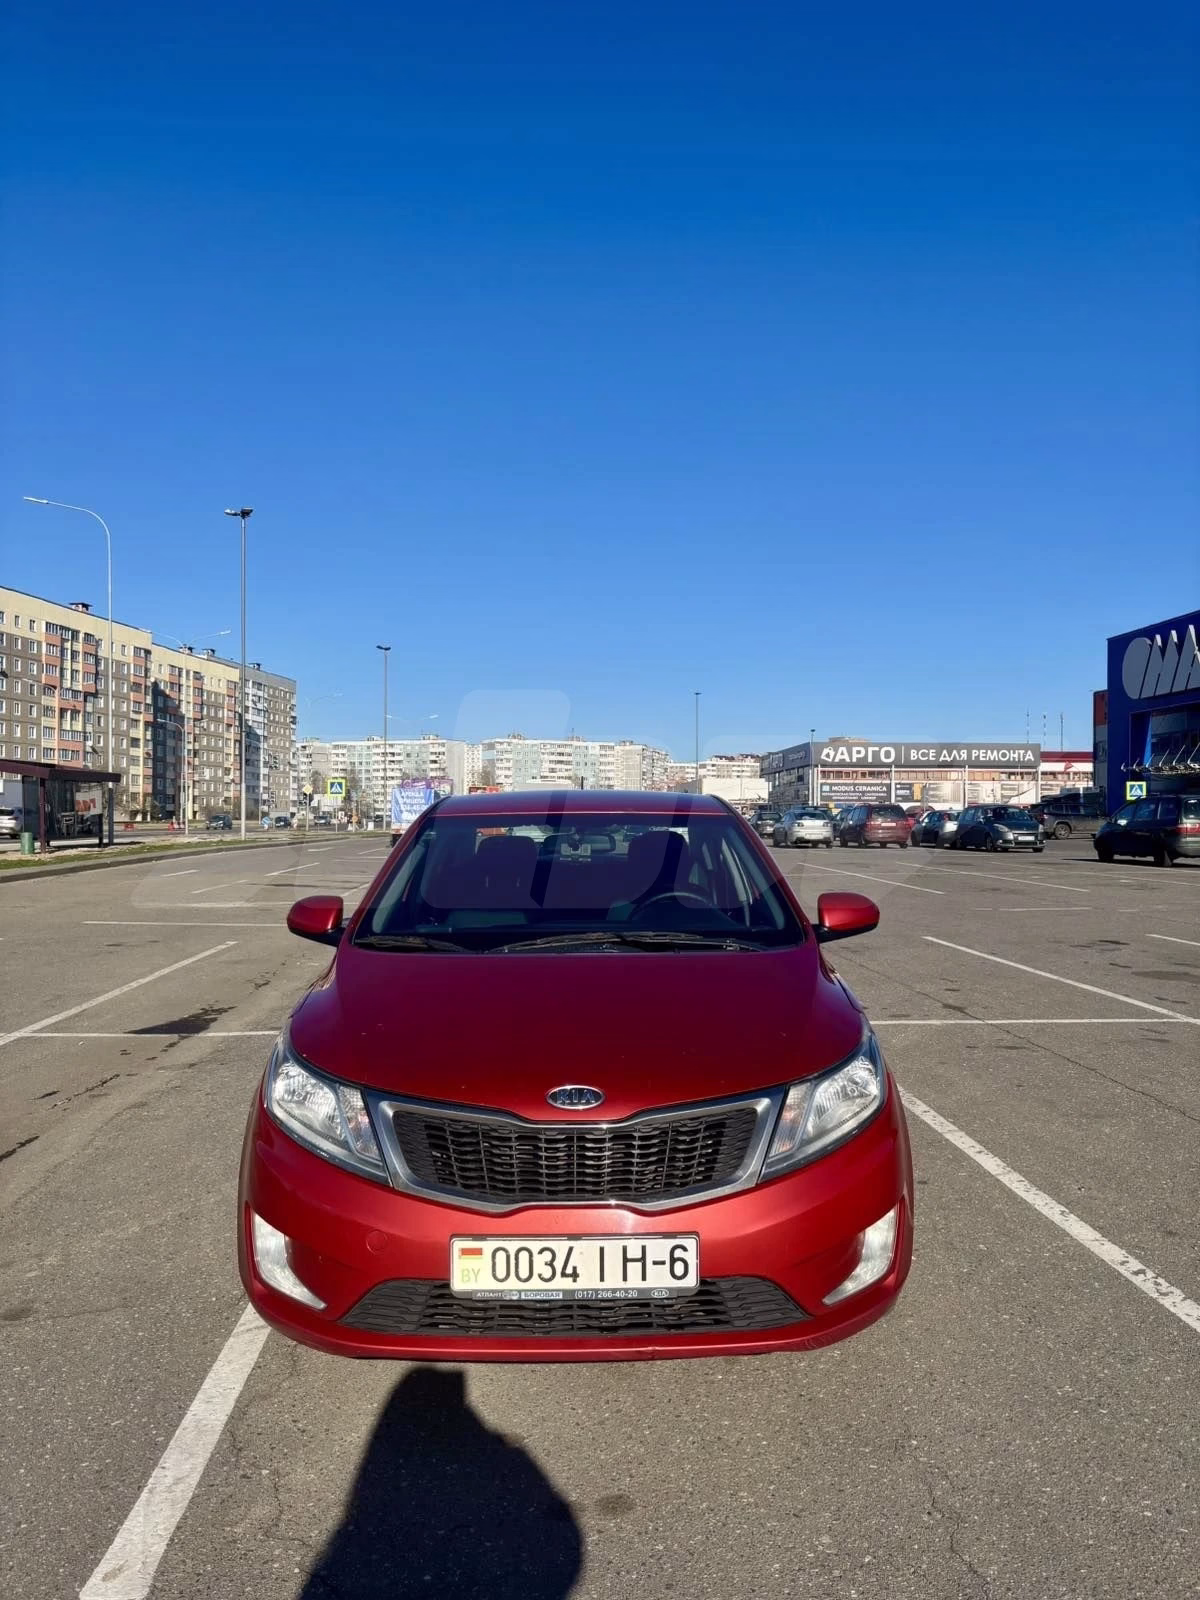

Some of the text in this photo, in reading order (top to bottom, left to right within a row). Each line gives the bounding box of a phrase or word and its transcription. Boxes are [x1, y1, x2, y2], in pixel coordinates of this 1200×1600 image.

[834, 746, 1035, 763] АРГО ВСЕ ДЛЯ РЕМОНТА
[491, 1246, 580, 1283] 0034
[461, 1268, 481, 1283] BY
[574, 1290, 596, 1299] (017)
[597, 1289, 638, 1298] 266-40-20
